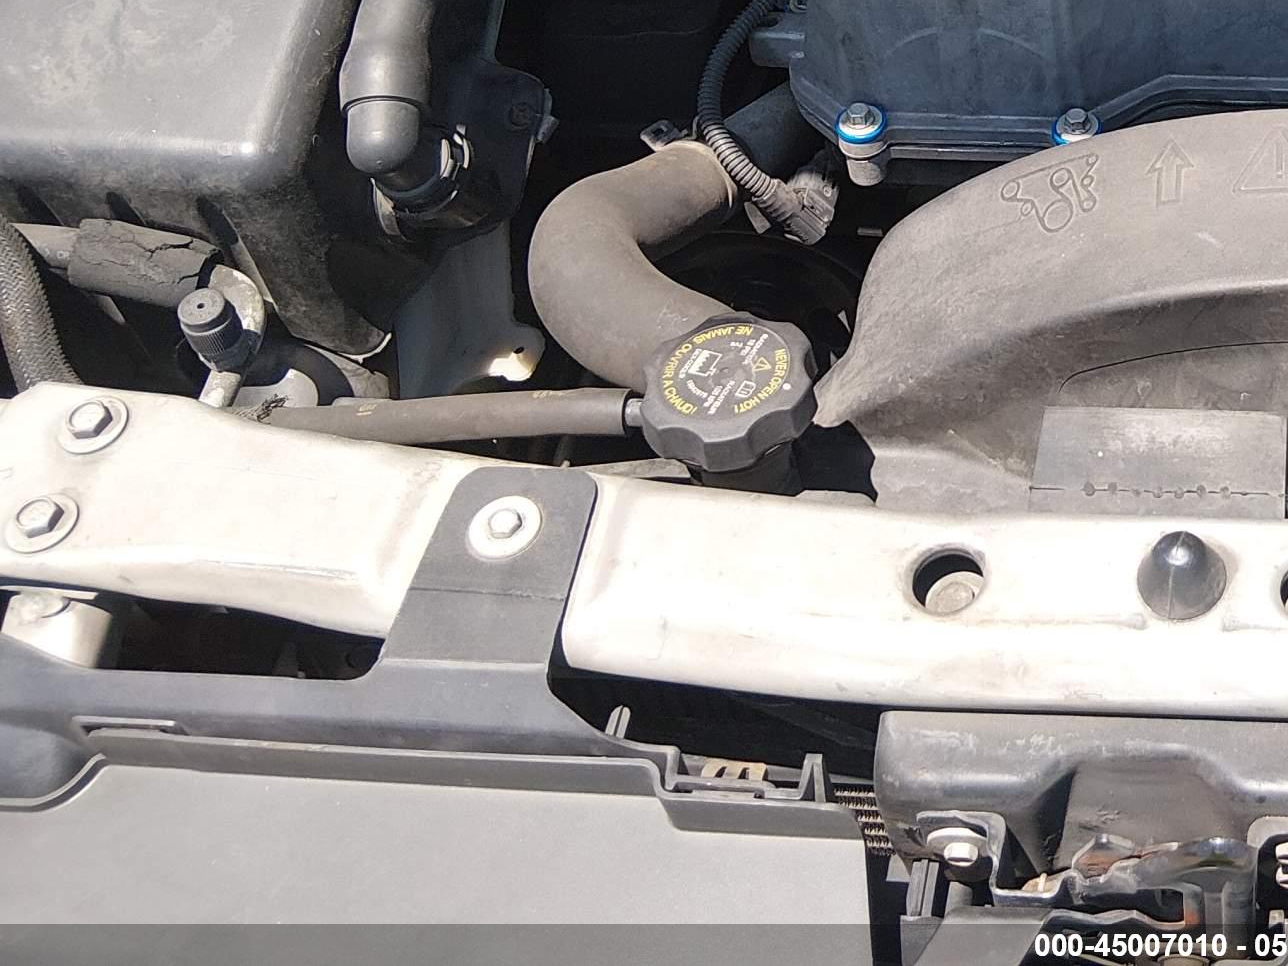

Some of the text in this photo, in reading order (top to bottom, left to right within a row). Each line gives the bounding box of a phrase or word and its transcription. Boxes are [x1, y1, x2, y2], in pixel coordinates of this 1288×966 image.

[693, 326, 735, 345] JAMAIS
[734, 324, 754, 336] NE
[662, 343, 693, 380] OUVRIR
[734, 348, 788, 414] NEVER OPEN HOT!
[664, 387, 698, 416] CHAUD!
